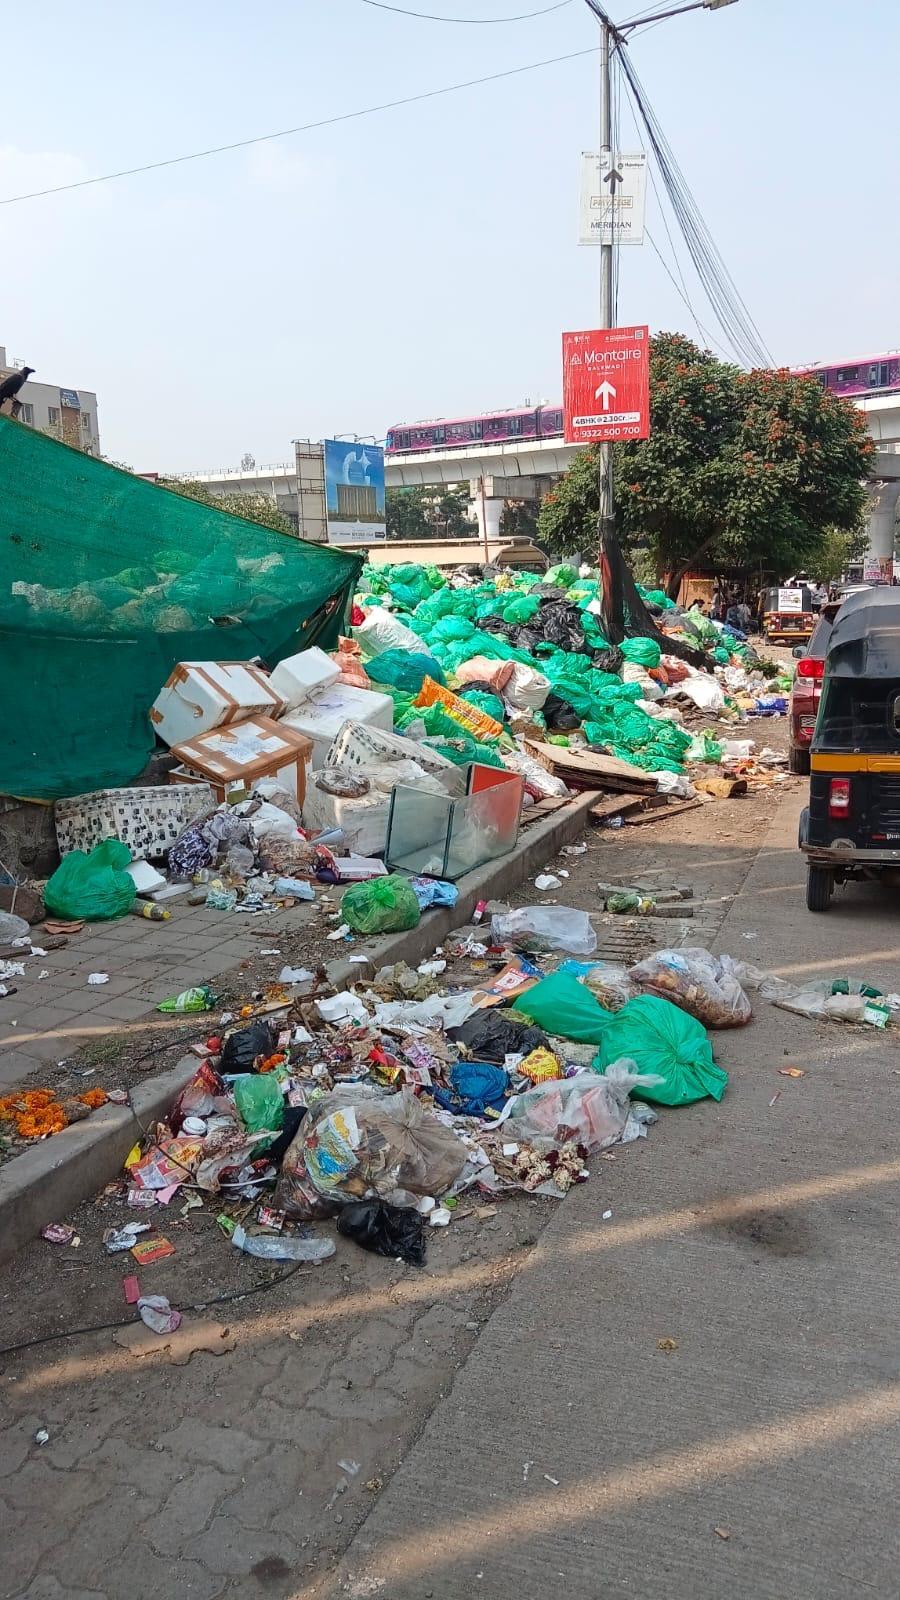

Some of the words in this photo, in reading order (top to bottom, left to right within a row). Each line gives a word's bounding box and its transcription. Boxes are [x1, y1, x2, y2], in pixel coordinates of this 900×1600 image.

[590, 221, 632, 229] MERIDIAN
[584, 349, 641, 363] Montaire
[581, 429, 602, 438] 9322
[604, 428, 621, 436] 500
[623, 426, 640, 435] 700
